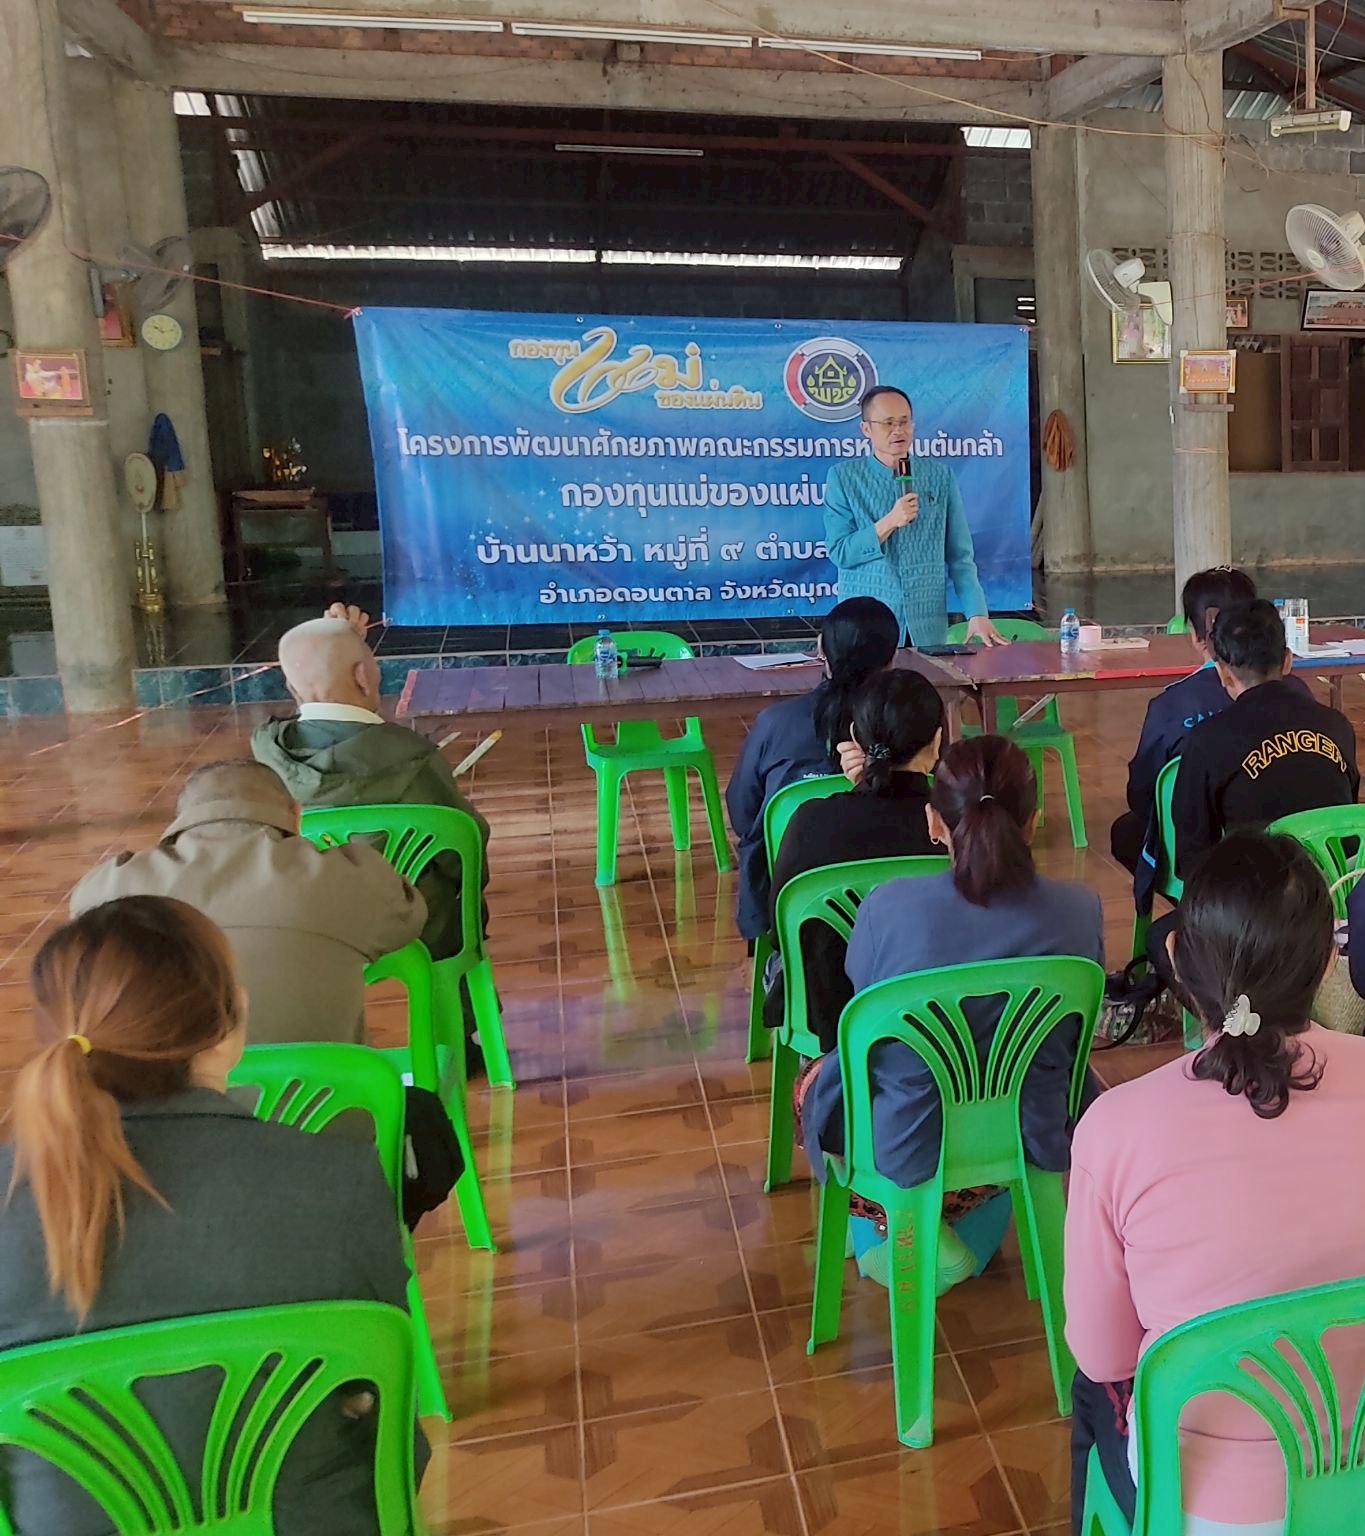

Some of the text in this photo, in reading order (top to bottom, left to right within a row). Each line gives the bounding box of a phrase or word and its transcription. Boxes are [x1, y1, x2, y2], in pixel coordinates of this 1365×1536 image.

[477, 536, 633, 564] บ้านนาหว้า
[644, 527, 710, 570] หมู่ที่
[720, 542, 744, 561] ๙
[539, 582, 712, 604] อำเภอดอนตาล
